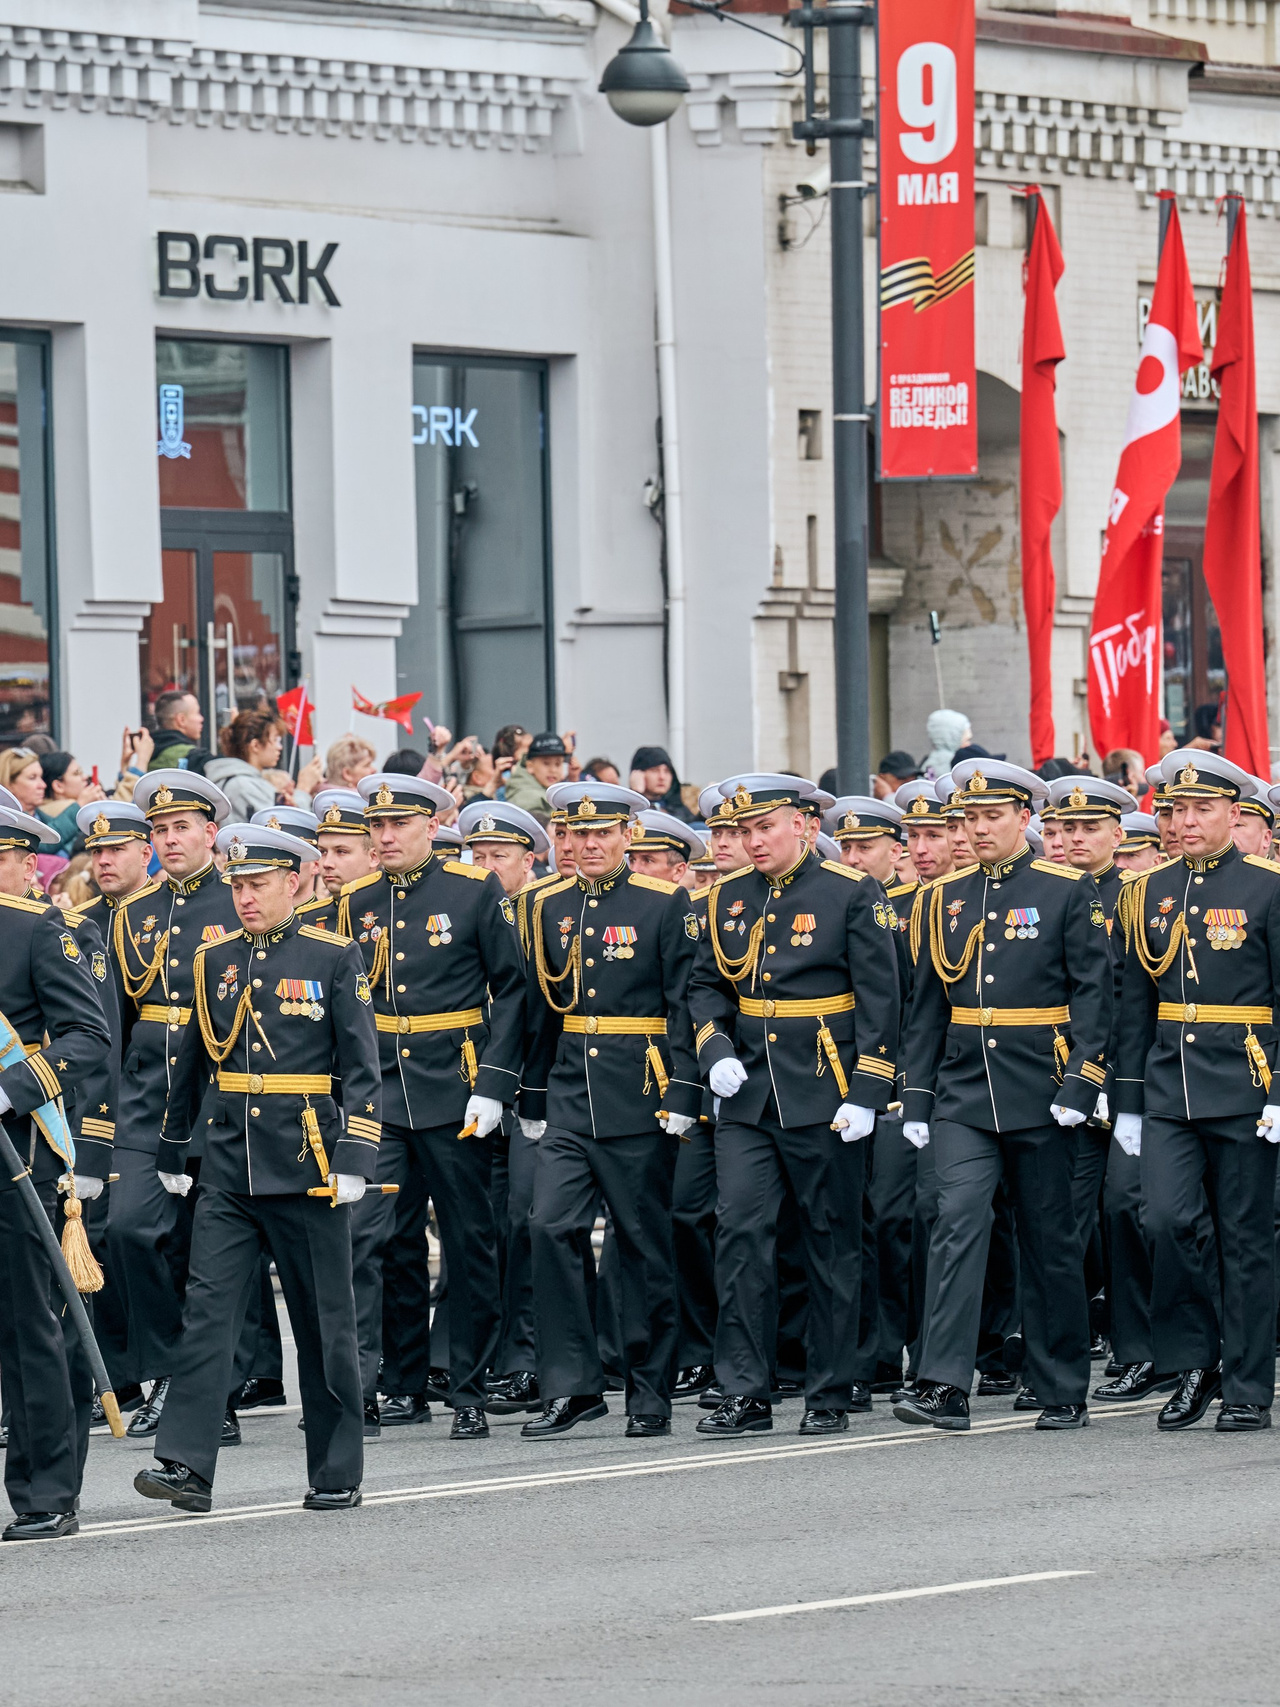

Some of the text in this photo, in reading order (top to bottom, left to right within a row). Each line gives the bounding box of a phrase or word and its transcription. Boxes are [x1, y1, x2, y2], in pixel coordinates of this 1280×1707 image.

[897, 41, 958, 165] 9
[897, 172, 959, 206] МАЯ
[158, 231, 341, 307] BORK
[890, 382, 968, 407] ВЕЛИКОЙ
[890, 405, 968, 430] ПОБЕДЫ!
